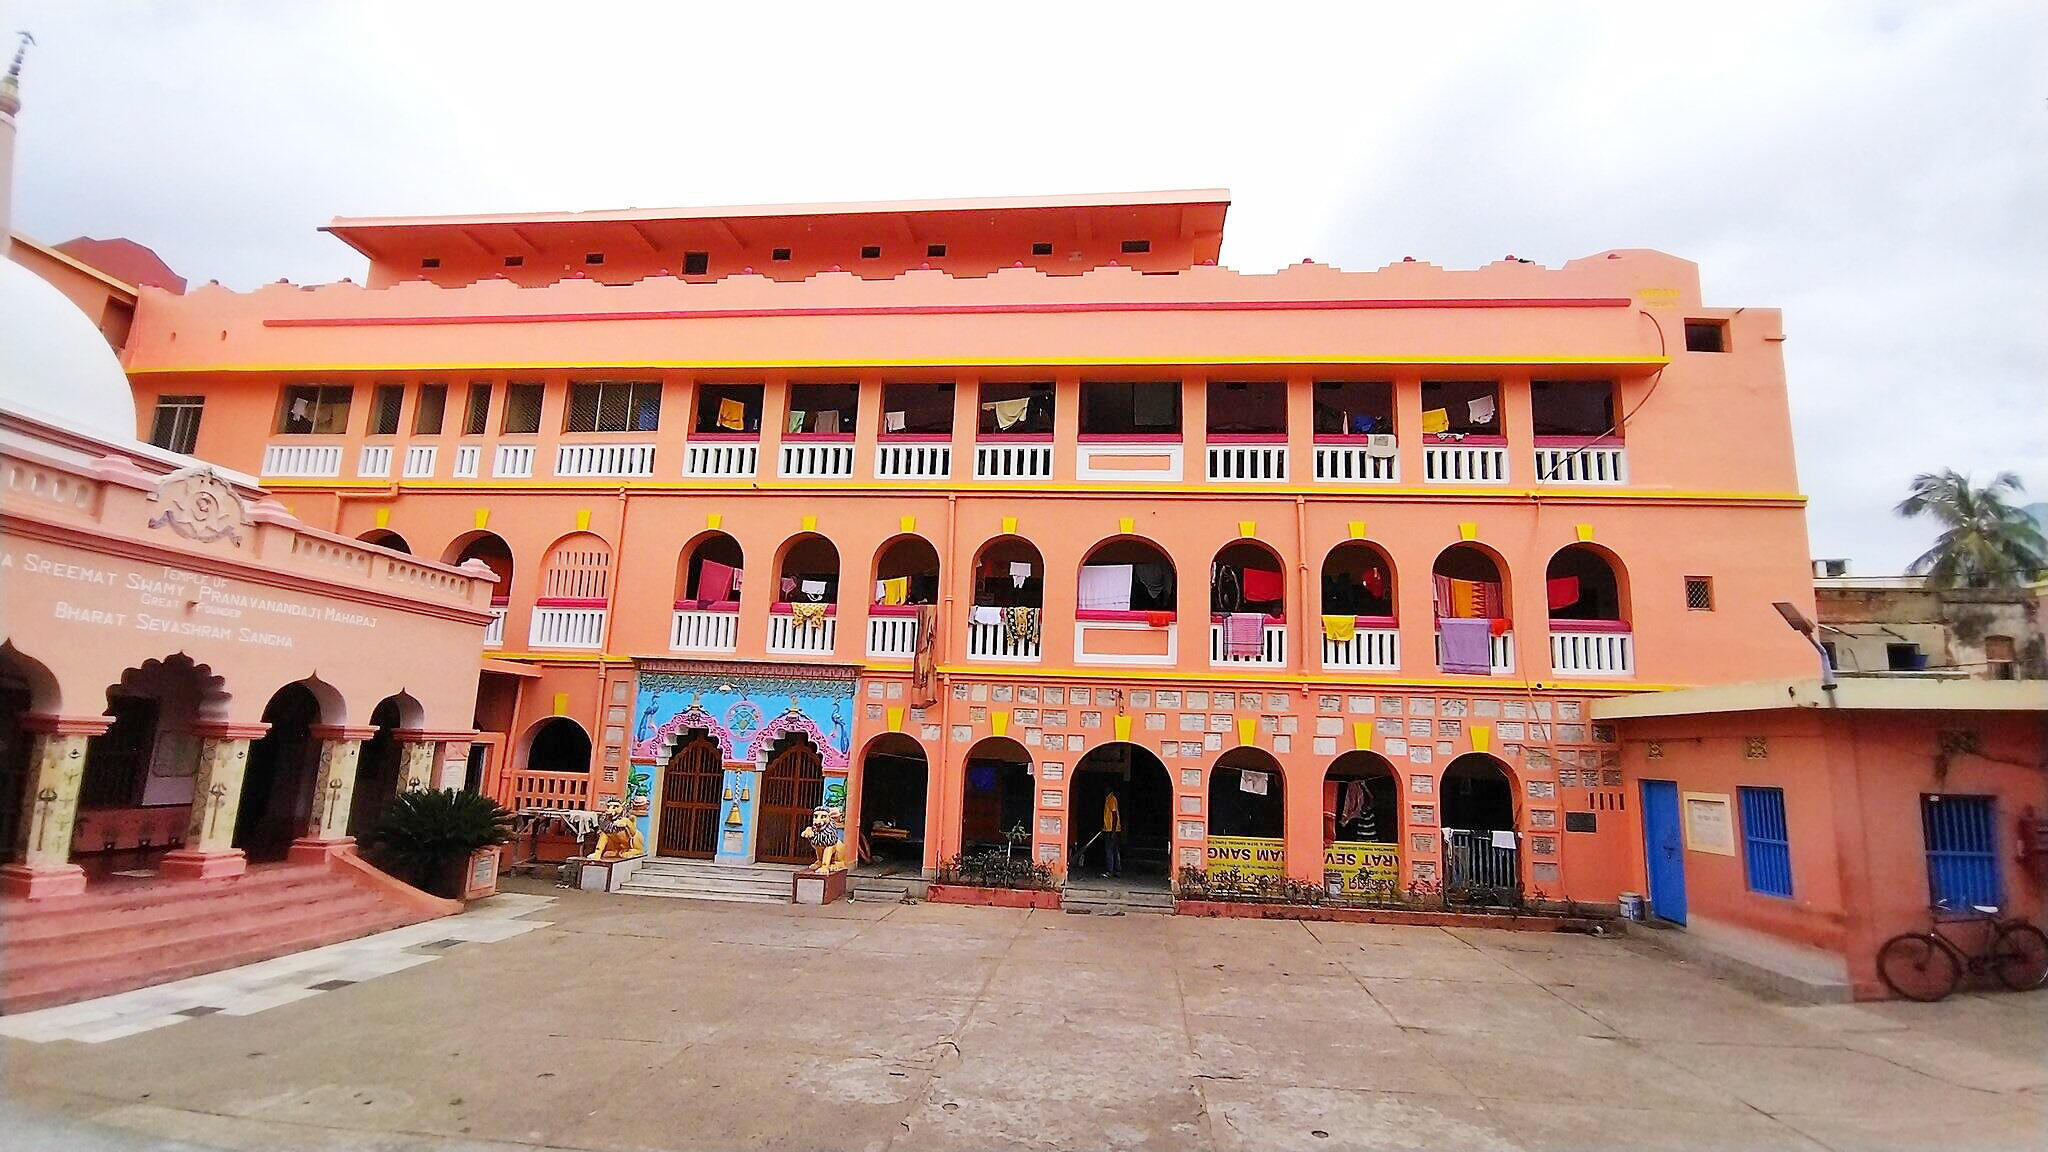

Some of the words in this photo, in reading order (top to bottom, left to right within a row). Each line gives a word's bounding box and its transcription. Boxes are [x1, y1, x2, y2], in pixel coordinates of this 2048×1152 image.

[24, 553, 118, 586] SREEMAT
[126, 573, 186, 597] SWAMY
[199, 585, 321, 620] PRANAVANANDAJI
[324, 607, 378, 628] MAHARAJ
[141, 592, 180, 608] GREAT
[55, 601, 127, 627] BHARAT
[136, 613, 232, 641] SEVASHRAM
[239, 627, 293, 648] SANGHA
[1207, 847, 1251, 861] SANG
